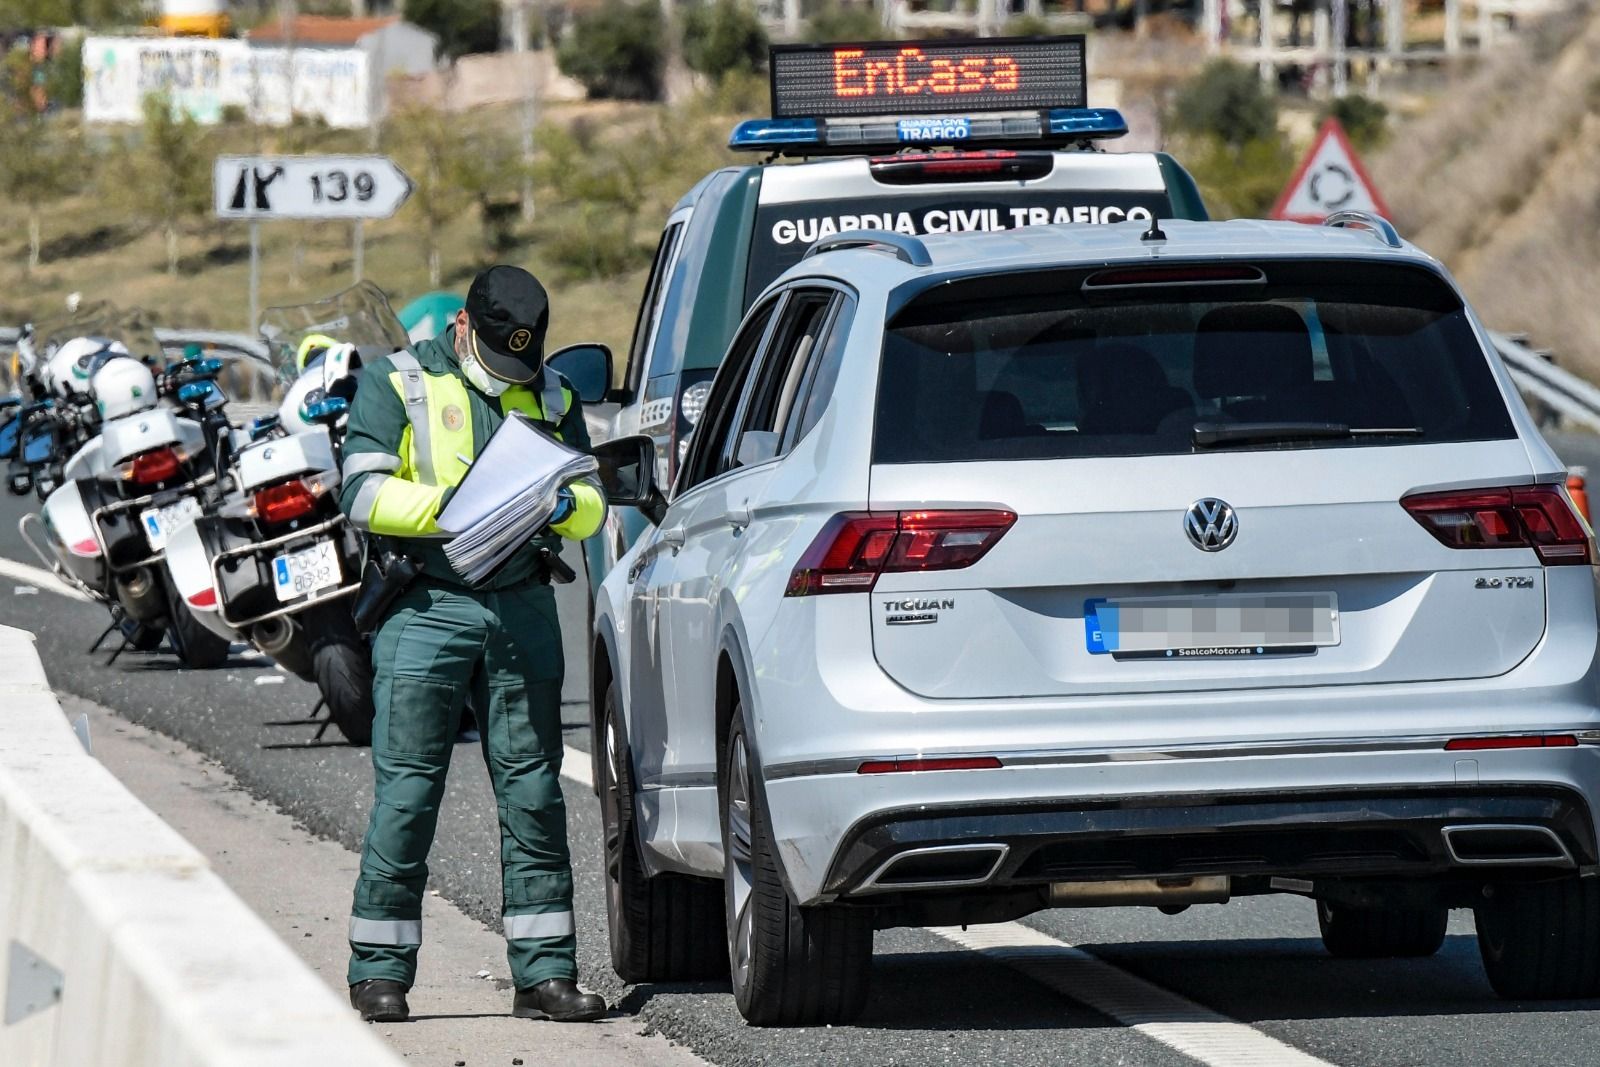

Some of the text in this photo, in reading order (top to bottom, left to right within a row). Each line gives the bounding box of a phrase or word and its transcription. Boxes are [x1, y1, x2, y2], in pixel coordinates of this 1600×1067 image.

[834, 48, 1019, 97] EnCasa
[900, 118, 968, 127] GUARDIA CIVIL
[901, 126, 967, 140] TRAFICO
[310, 171, 375, 202] 139
[772, 212, 917, 245] GUARDIA
[923, 208, 1006, 235] CIVIL
[1505, 575, 1534, 589] TDI
[882, 598, 955, 611] TIGUAN
[1178, 647, 1251, 657] SealcoMotor.es
